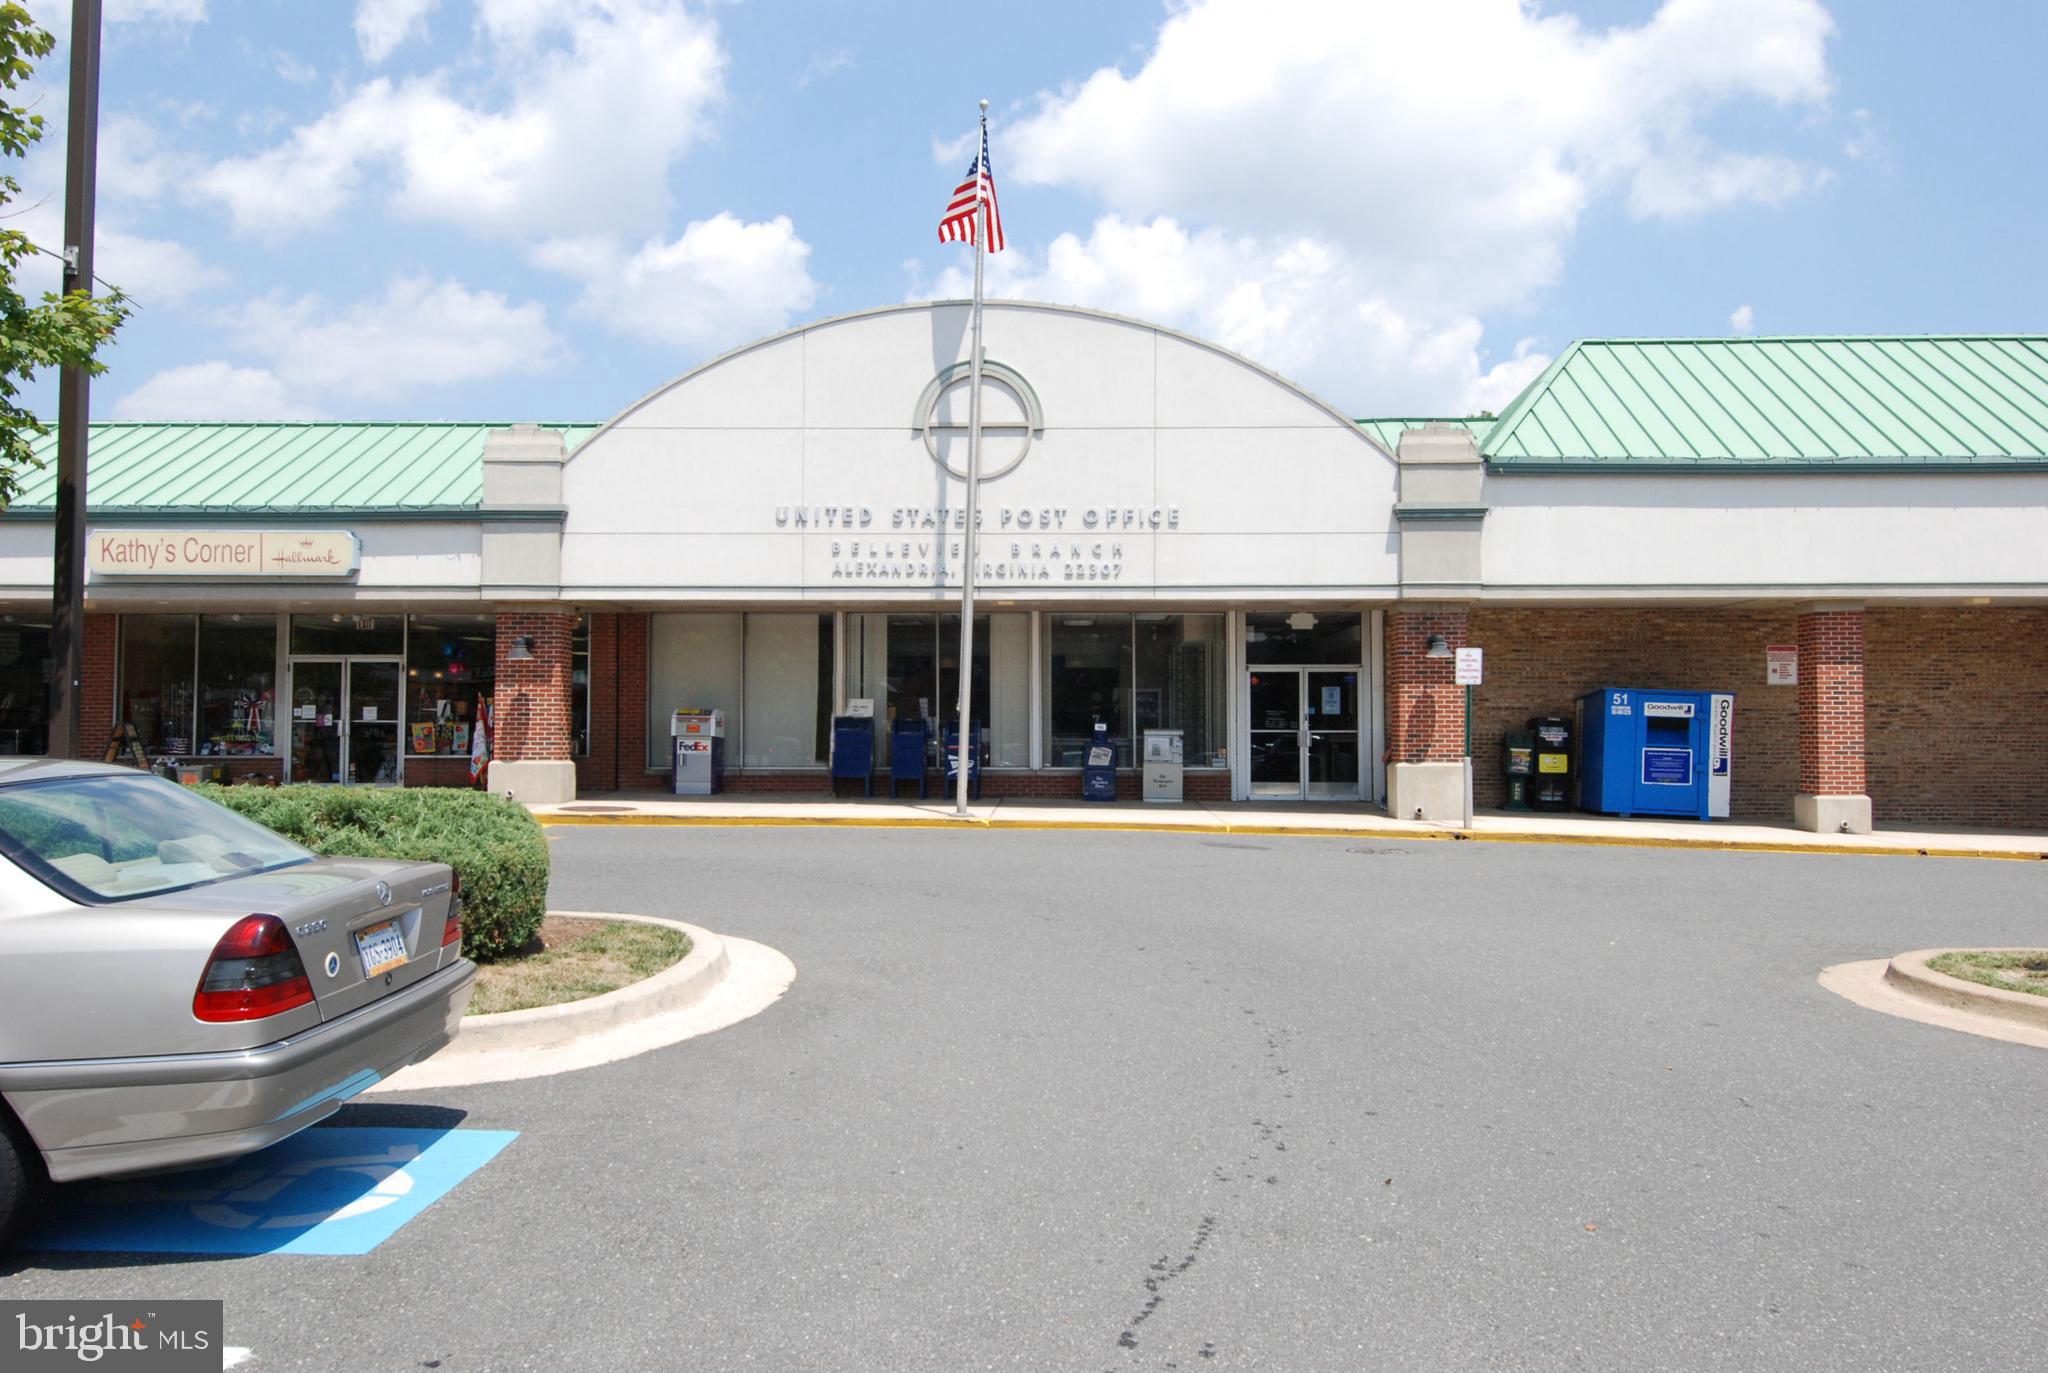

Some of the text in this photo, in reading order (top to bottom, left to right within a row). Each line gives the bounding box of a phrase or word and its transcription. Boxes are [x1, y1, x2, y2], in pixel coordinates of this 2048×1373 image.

[776, 506, 1179, 529] UNITED STATES POST OFFICE
[101, 537, 341, 570] Kathy's Corner Hallmark
[832, 542, 1122, 559] BELLEVIE BRANCH
[962, 564, 1049, 579] IRGINIA
[1613, 693, 1628, 705] 51
[1719, 699, 1730, 757] Goodwill
[680, 741, 708, 752] FedEx
